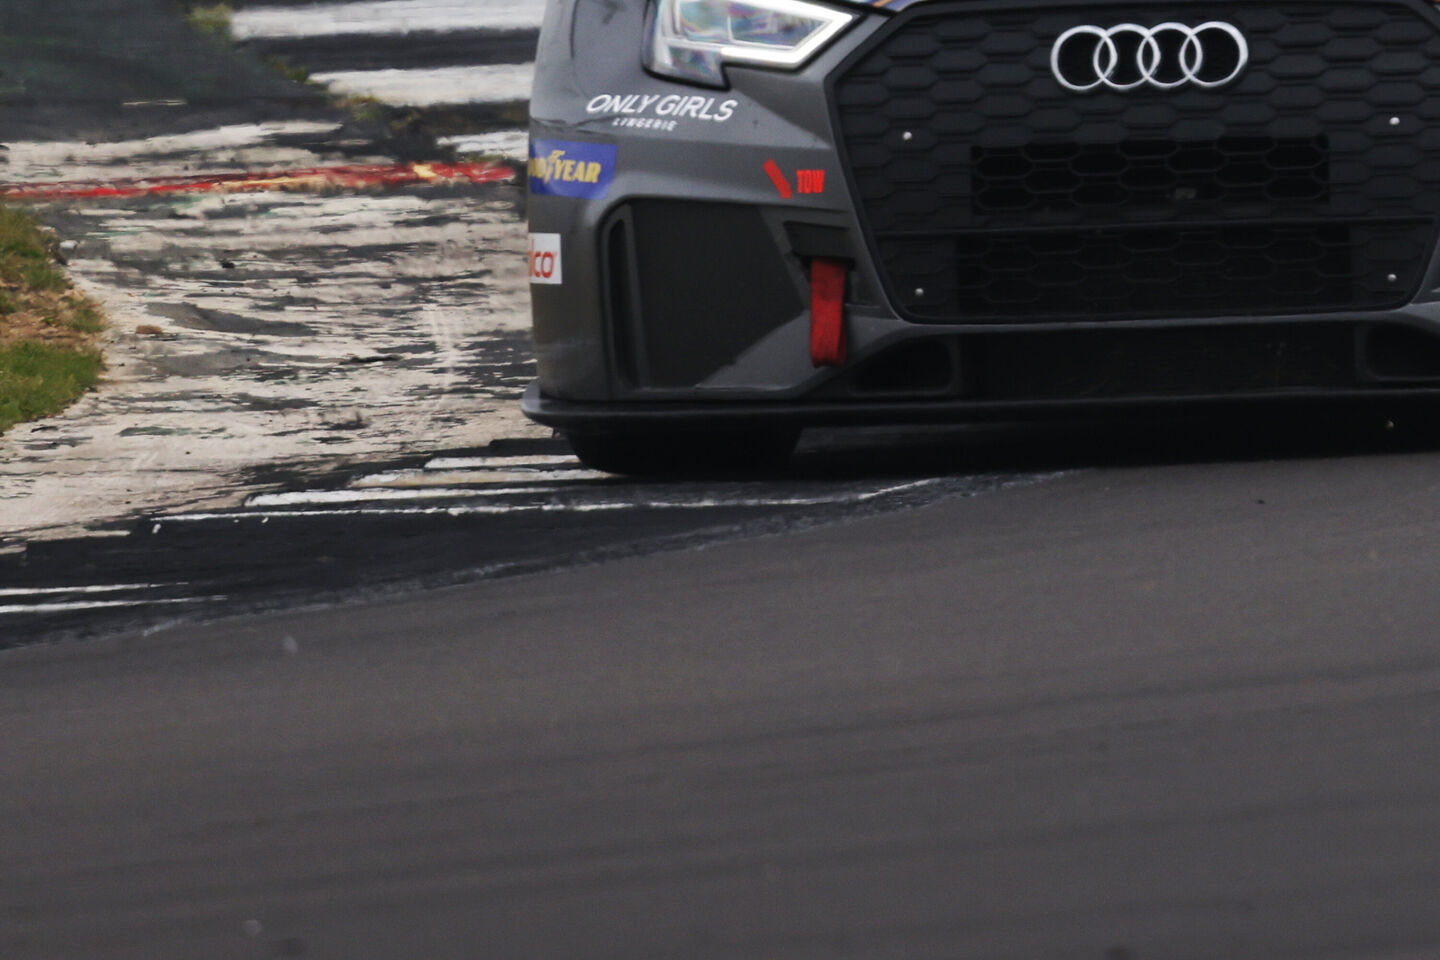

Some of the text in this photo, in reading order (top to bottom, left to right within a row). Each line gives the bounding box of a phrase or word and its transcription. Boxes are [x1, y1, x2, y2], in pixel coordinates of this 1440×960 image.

[586, 93, 739, 122] ONLY GIRLS
[612, 117, 678, 131] LINGERIE
[796, 169, 826, 195] TOW
